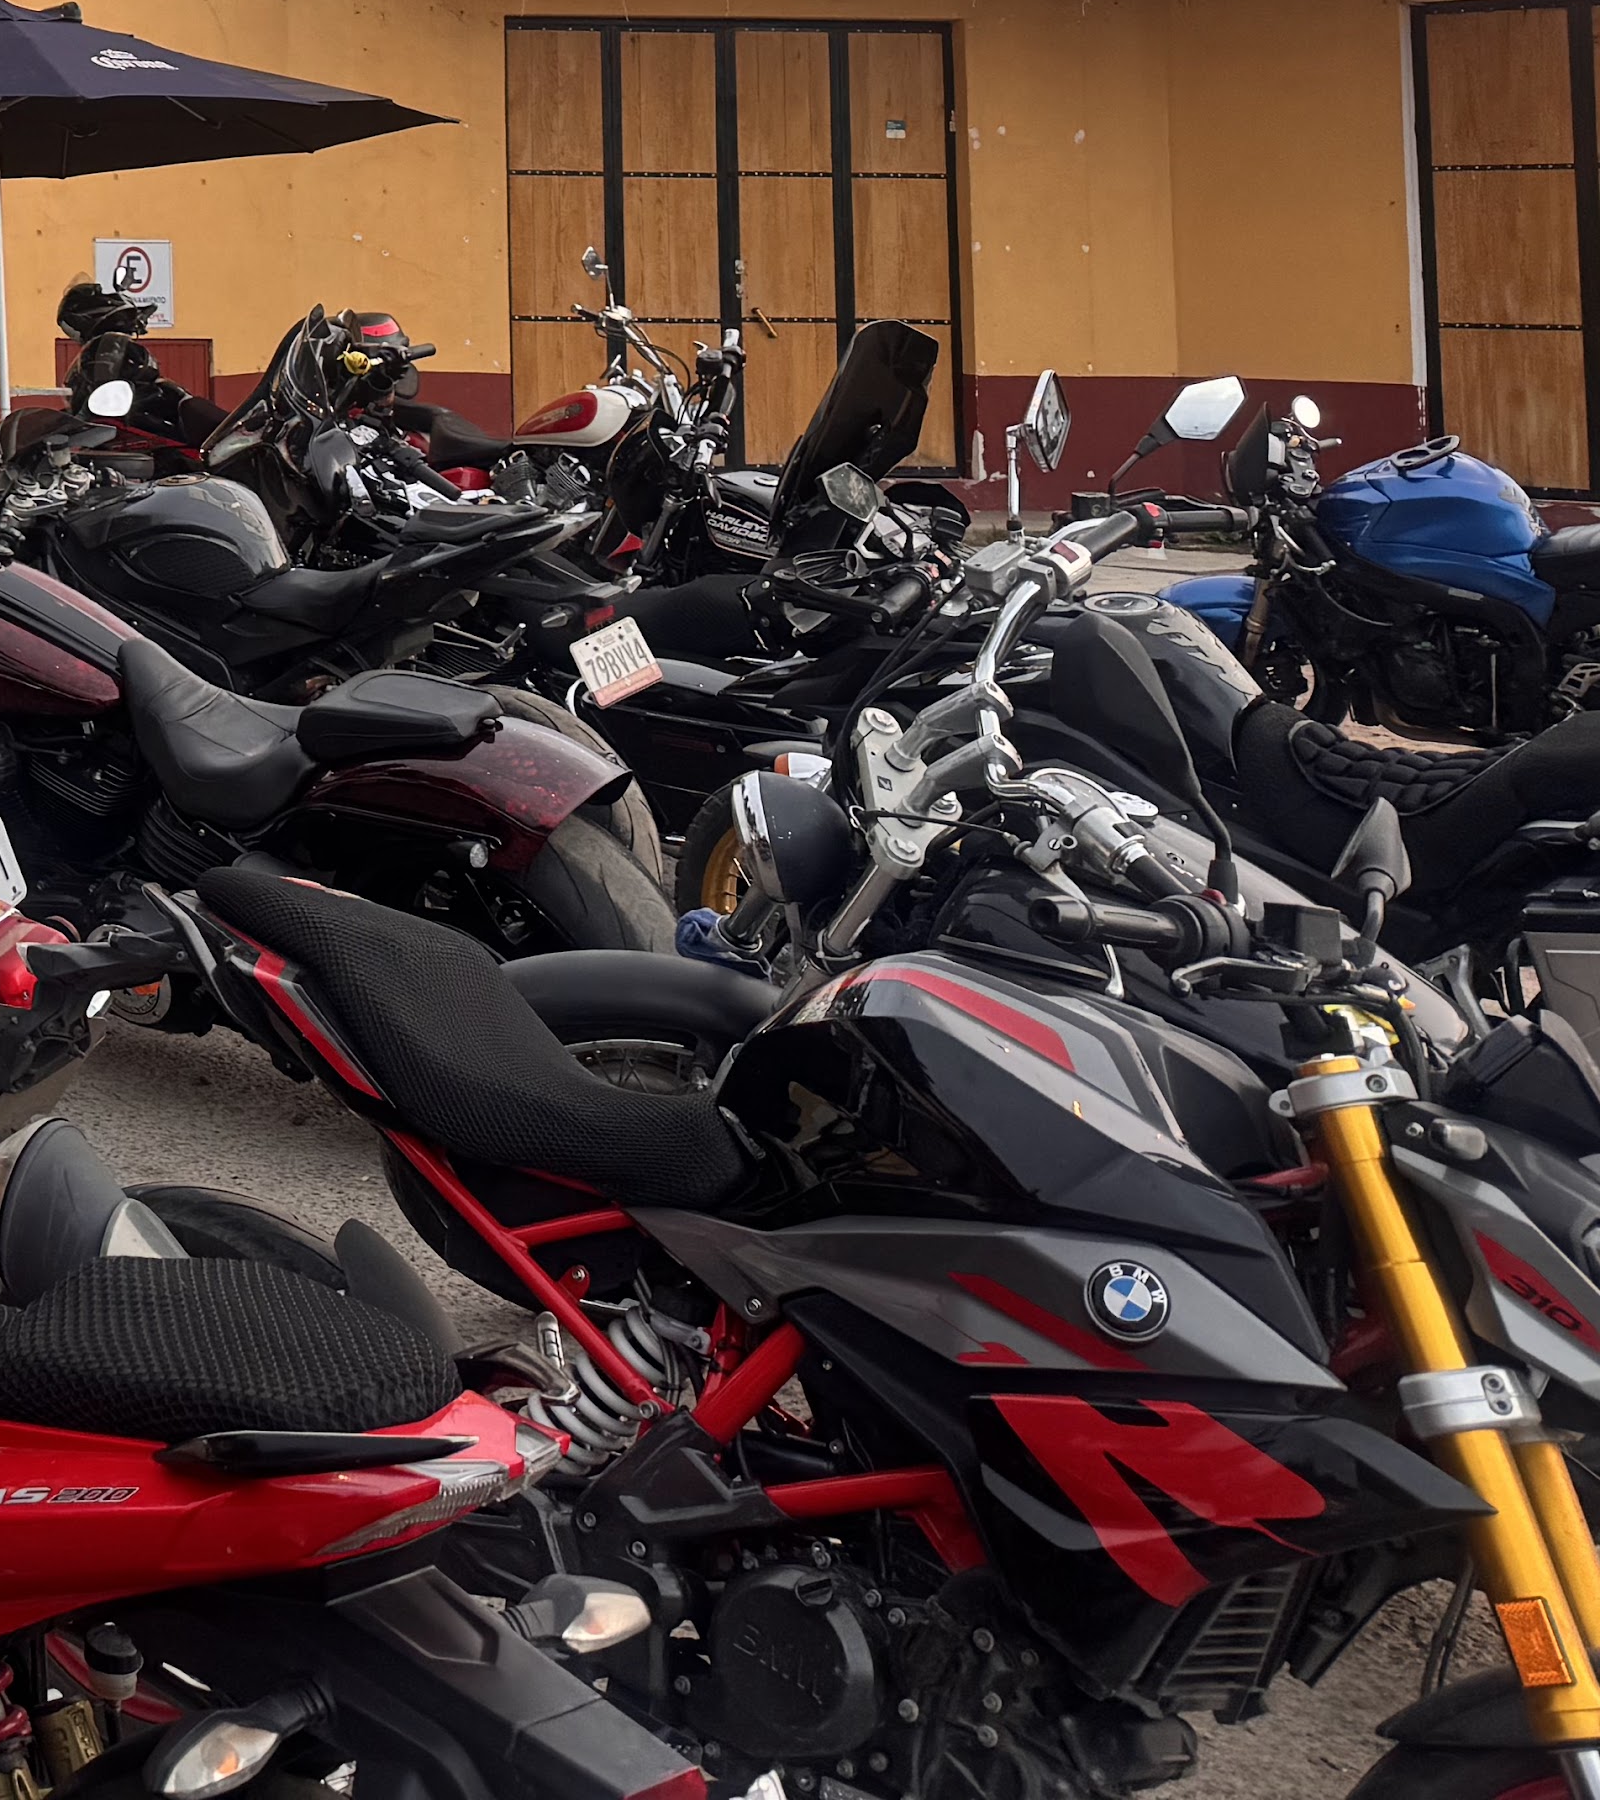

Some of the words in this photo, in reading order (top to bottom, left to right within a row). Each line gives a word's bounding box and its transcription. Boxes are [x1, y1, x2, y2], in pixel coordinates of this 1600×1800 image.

[585, 637, 651, 688] 79BVV4
[1108, 1262, 1165, 1304] BMW
[1504, 1274, 1581, 1331] 310
[47, 1486, 140, 1504] 200
